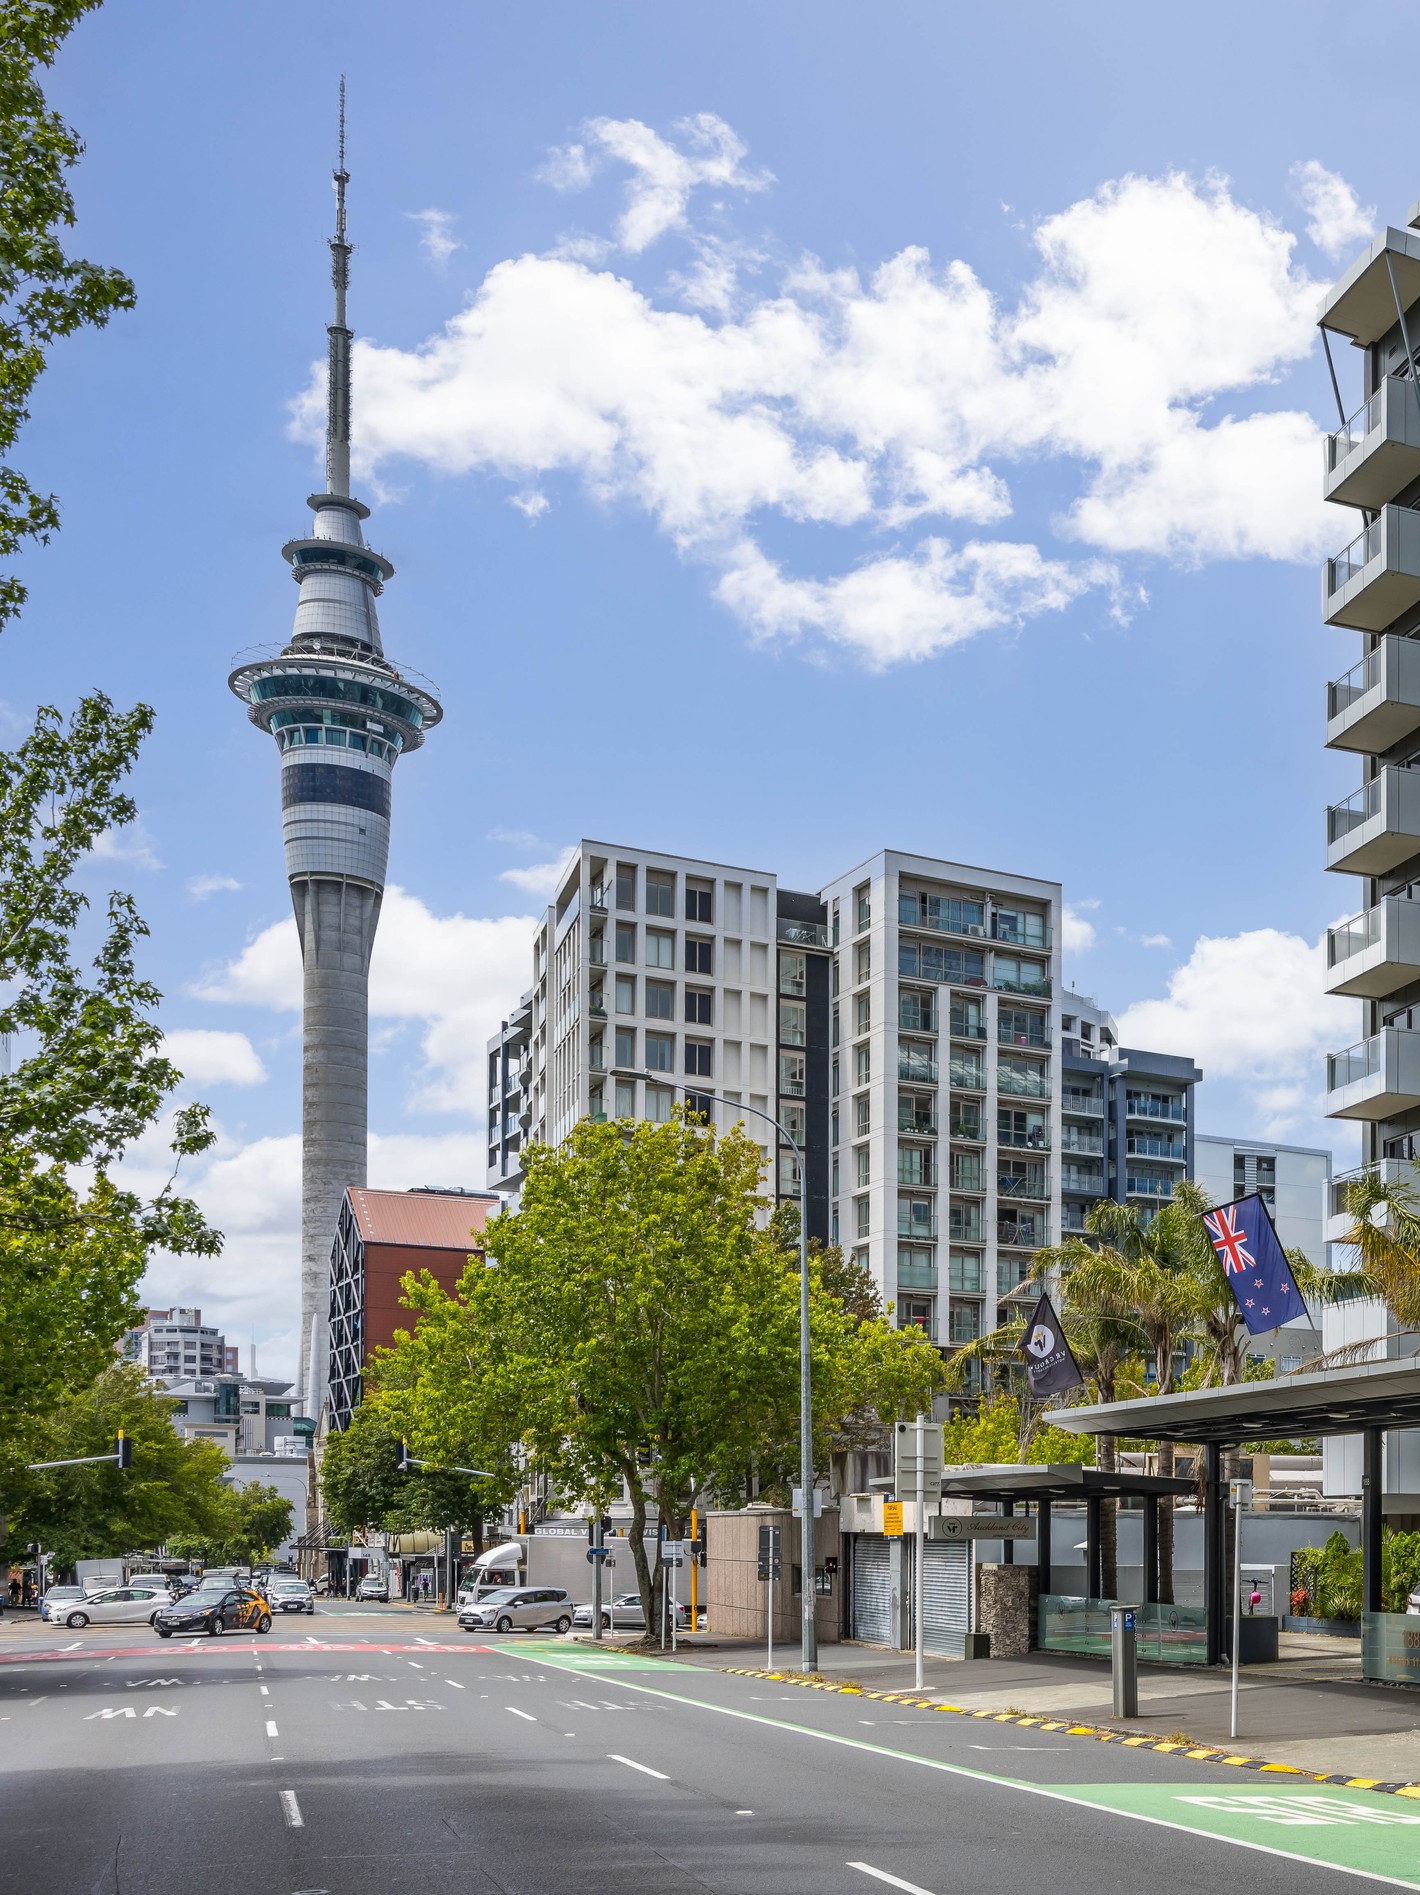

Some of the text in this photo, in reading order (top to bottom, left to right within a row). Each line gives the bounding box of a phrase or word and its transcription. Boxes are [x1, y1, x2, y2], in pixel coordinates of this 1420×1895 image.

[534, 1528, 578, 1536] GLOBAL
[967, 1521, 1029, 1535] Auckland City
[1402, 1631, 1420, 1649] 188
